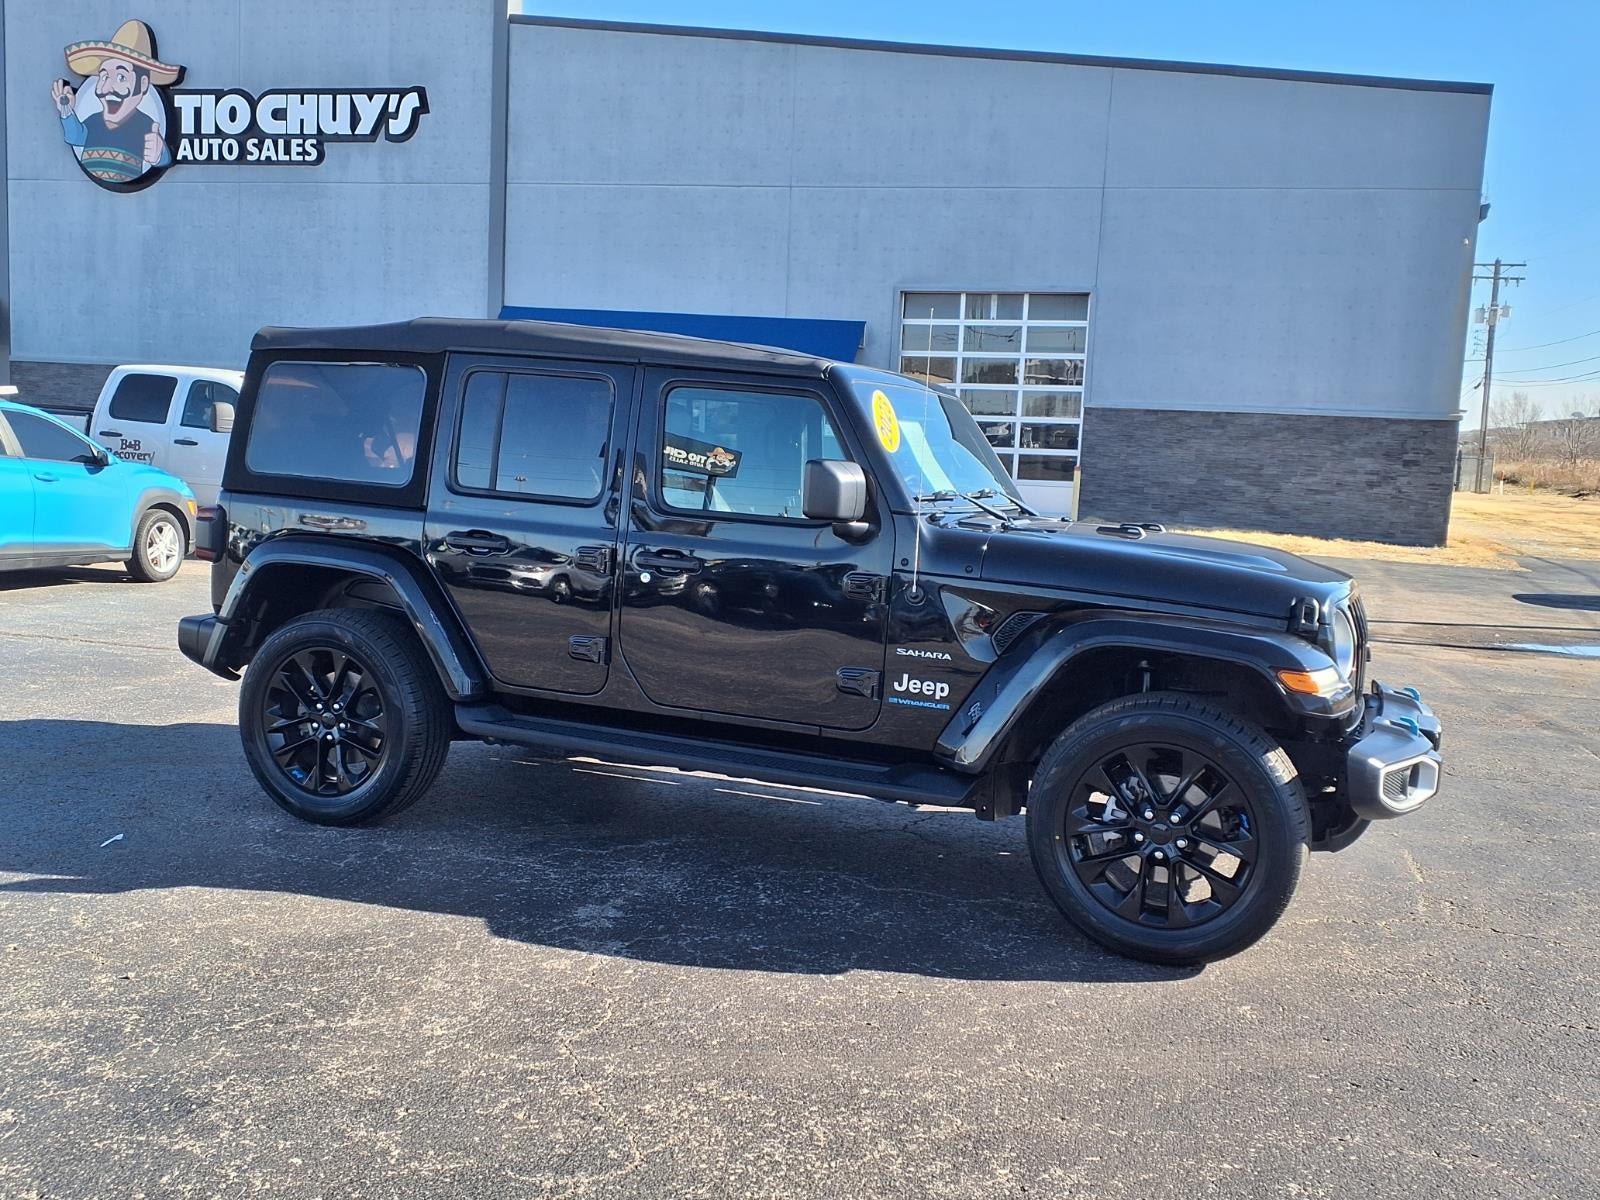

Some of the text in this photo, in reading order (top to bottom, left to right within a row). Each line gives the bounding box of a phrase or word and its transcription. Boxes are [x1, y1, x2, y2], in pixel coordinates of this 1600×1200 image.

[174, 92, 420, 135] TIO CHUY'S
[176, 138, 318, 161] AUTO SALES
[120, 439, 141, 451] B&B
[896, 648, 951, 660] SAHARA
[894, 674, 949, 700] Jeep
